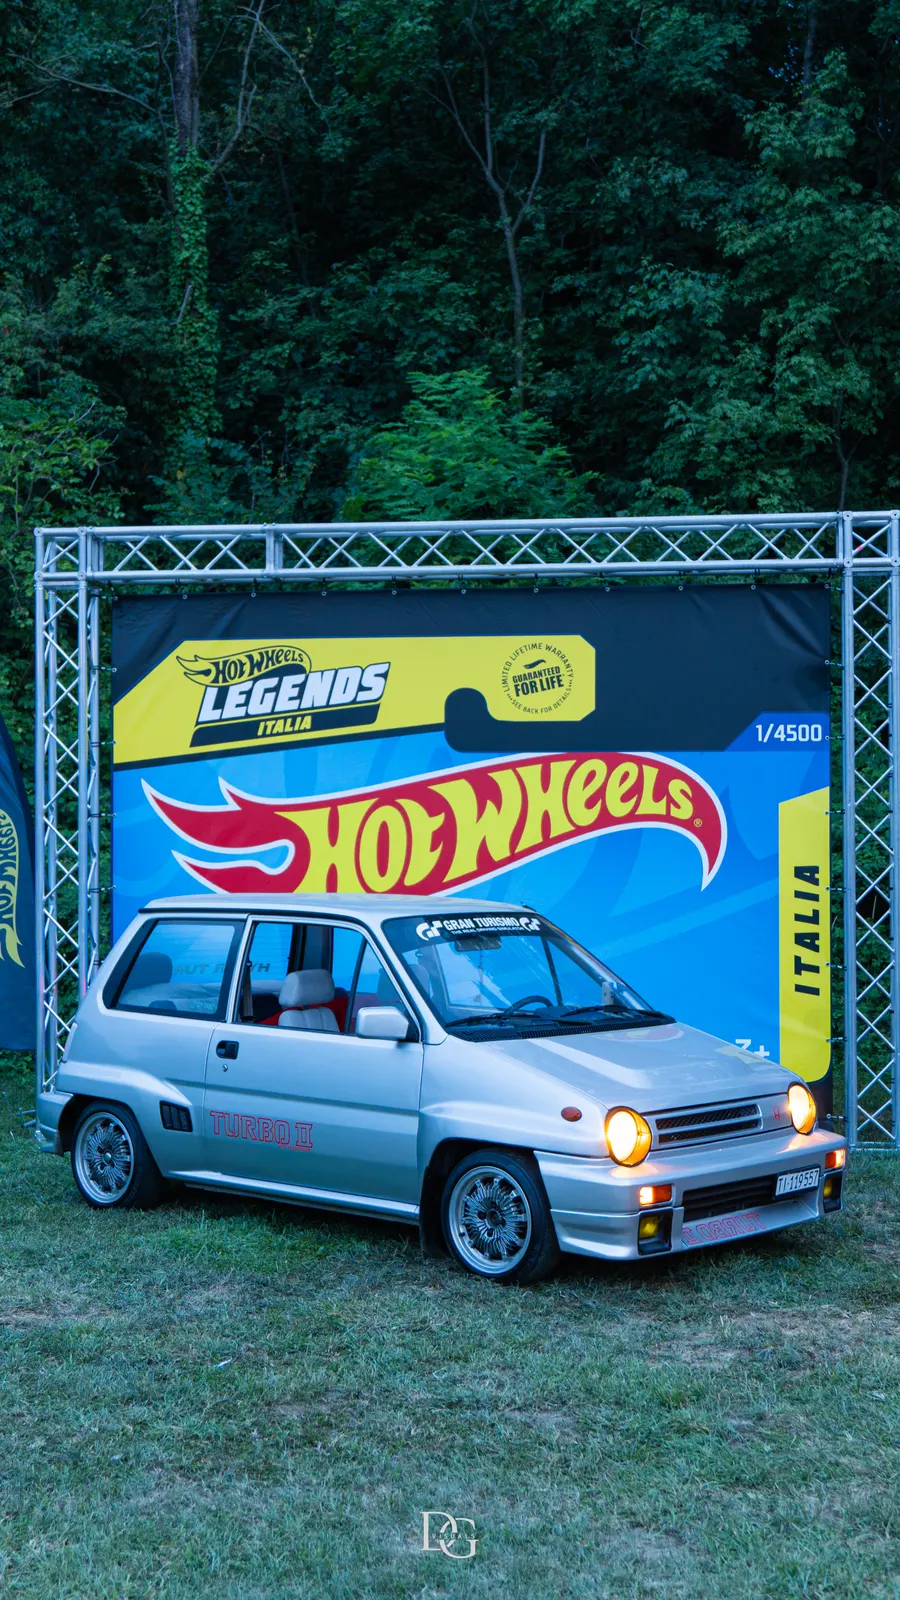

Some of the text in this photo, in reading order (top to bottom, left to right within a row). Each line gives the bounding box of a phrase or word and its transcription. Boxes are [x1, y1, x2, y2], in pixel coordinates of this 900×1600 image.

[502, 643, 574, 692] LIMITED LIFETIME WARRANTY
[512, 666, 561, 683] GUARANTEED
[197, 661, 390, 722] LEGENDS
[514, 674, 564, 697] FOR LIFE
[511, 688, 571, 714] SEE BACK FOR DETAILS
[257, 715, 312, 736] ITALIA
[755, 723, 823, 743] 1/4500
[443, 919, 475, 931] GRAN
[473, 916, 520, 927] TURISMO
[794, 865, 820, 996] ITALIA
[210, 1110, 313, 1148] TURBO II
[777, 1169, 819, 1194] TI-119557
